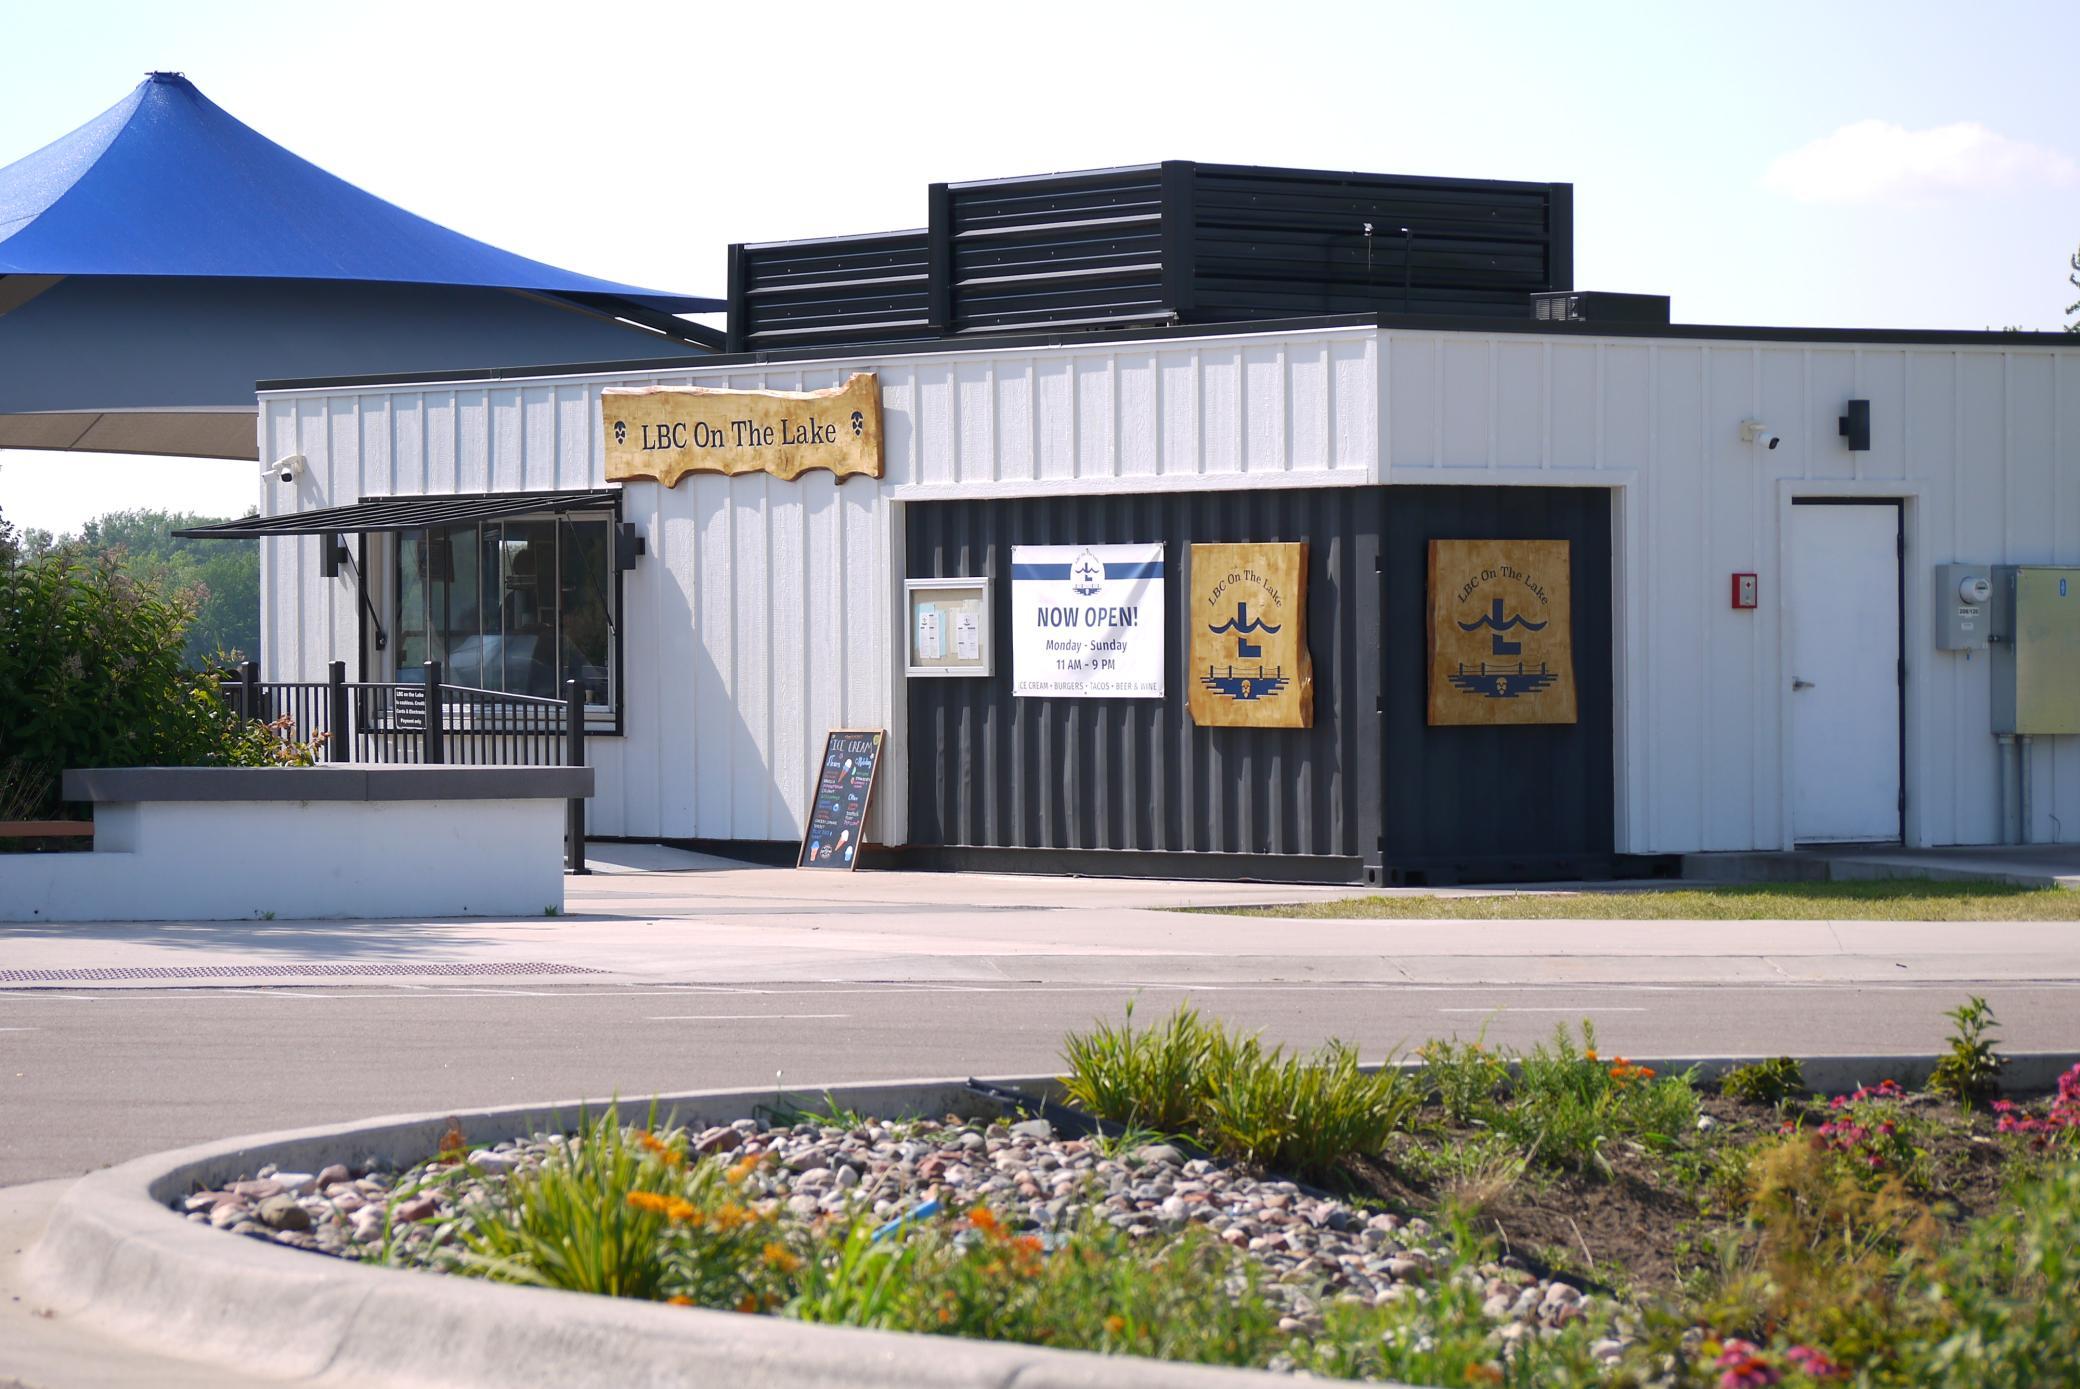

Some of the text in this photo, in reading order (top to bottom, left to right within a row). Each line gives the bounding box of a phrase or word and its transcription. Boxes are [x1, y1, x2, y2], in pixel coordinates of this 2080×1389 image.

[641, 417, 837, 450] LBC On The Lake
[1208, 569, 1282, 608] LBC On The Lake
[1457, 566, 1548, 605] LBC On The Lake
[1037, 606, 1138, 627] NOW OPEN!
[1045, 639, 1082, 653] Monday
[1090, 639, 1127, 653] Sunday
[1056, 660, 1065, 670] 11
[1067, 659, 1082, 670] AM
[1092, 659, 1098, 670] 9
[1101, 659, 1115, 670] PM
[1028, 682, 1049, 690] CREAM
[1054, 682, 1084, 690] BURGERS
[1090, 682, 1110, 690] TACOS
[831, 739, 873, 754] ICE CREAM
